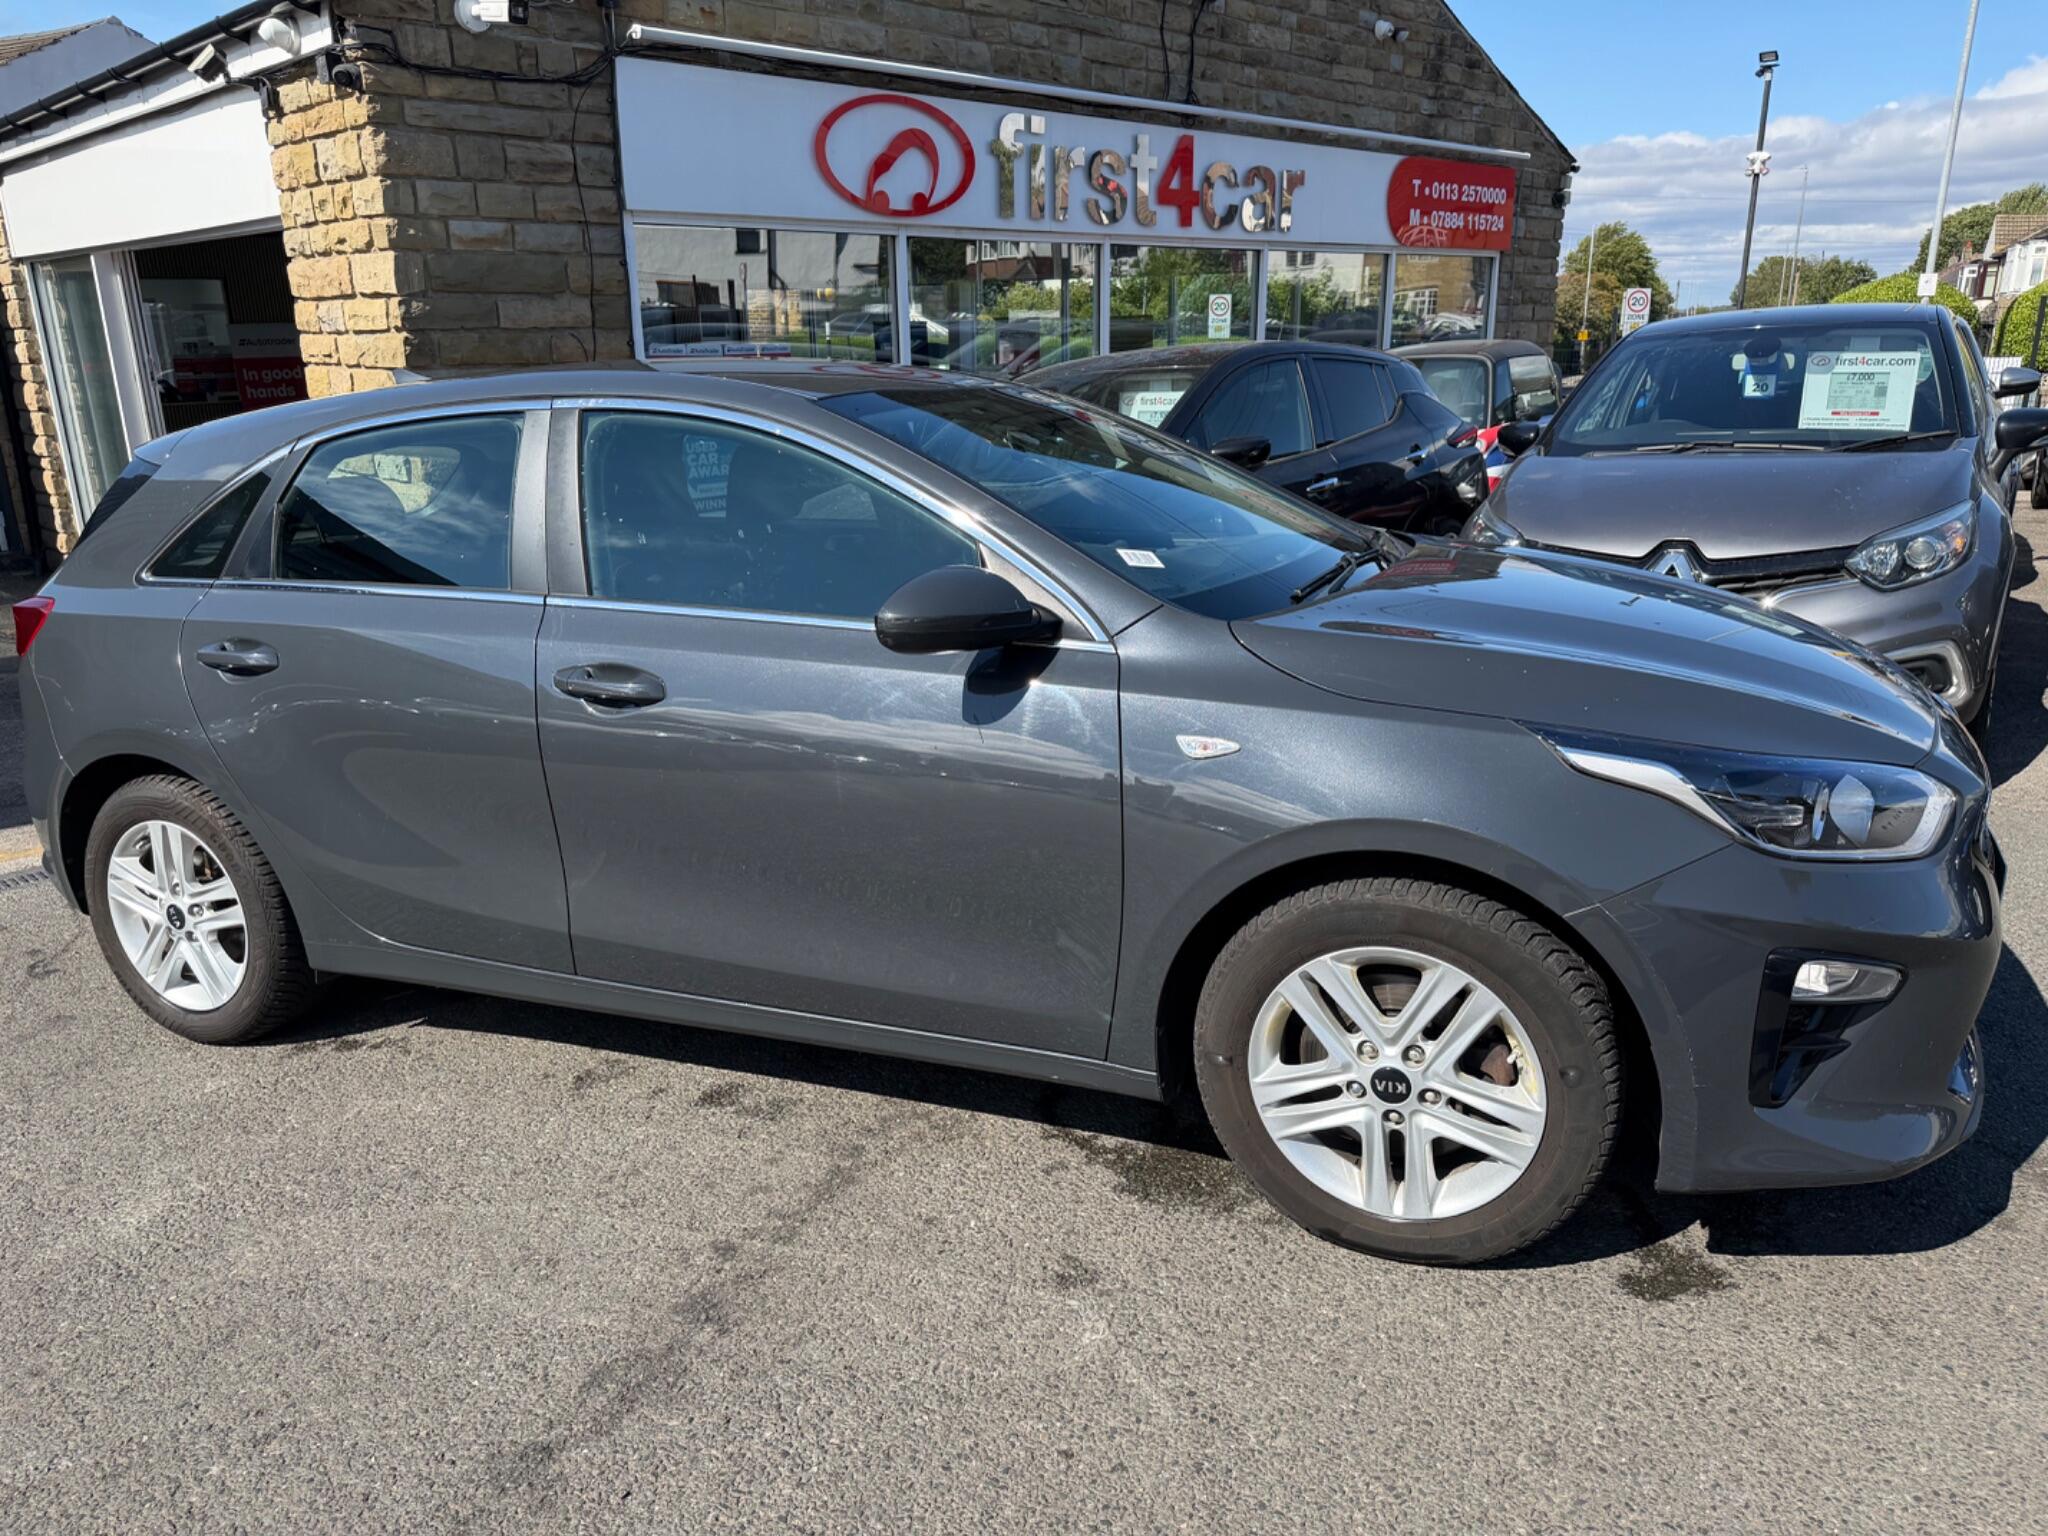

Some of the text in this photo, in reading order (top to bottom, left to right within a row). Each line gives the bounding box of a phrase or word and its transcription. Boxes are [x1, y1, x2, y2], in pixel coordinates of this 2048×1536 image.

[990, 112, 1306, 233] first4car
[1412, 179, 1507, 204] T 0113 2570000
[1409, 208, 1505, 231] M 07884 115724
[1214, 302, 1227, 311] 20
[1631, 297, 1646, 306] 20
[1835, 356, 1916, 367] first4car.com
[242, 365, 303, 383] In good
[245, 383, 297, 399] hands
[1752, 382, 1769, 392] 20
[686, 441, 718, 454] USED
[686, 452, 719, 466] CAR
[1374, 1079, 1407, 1094] KIA
